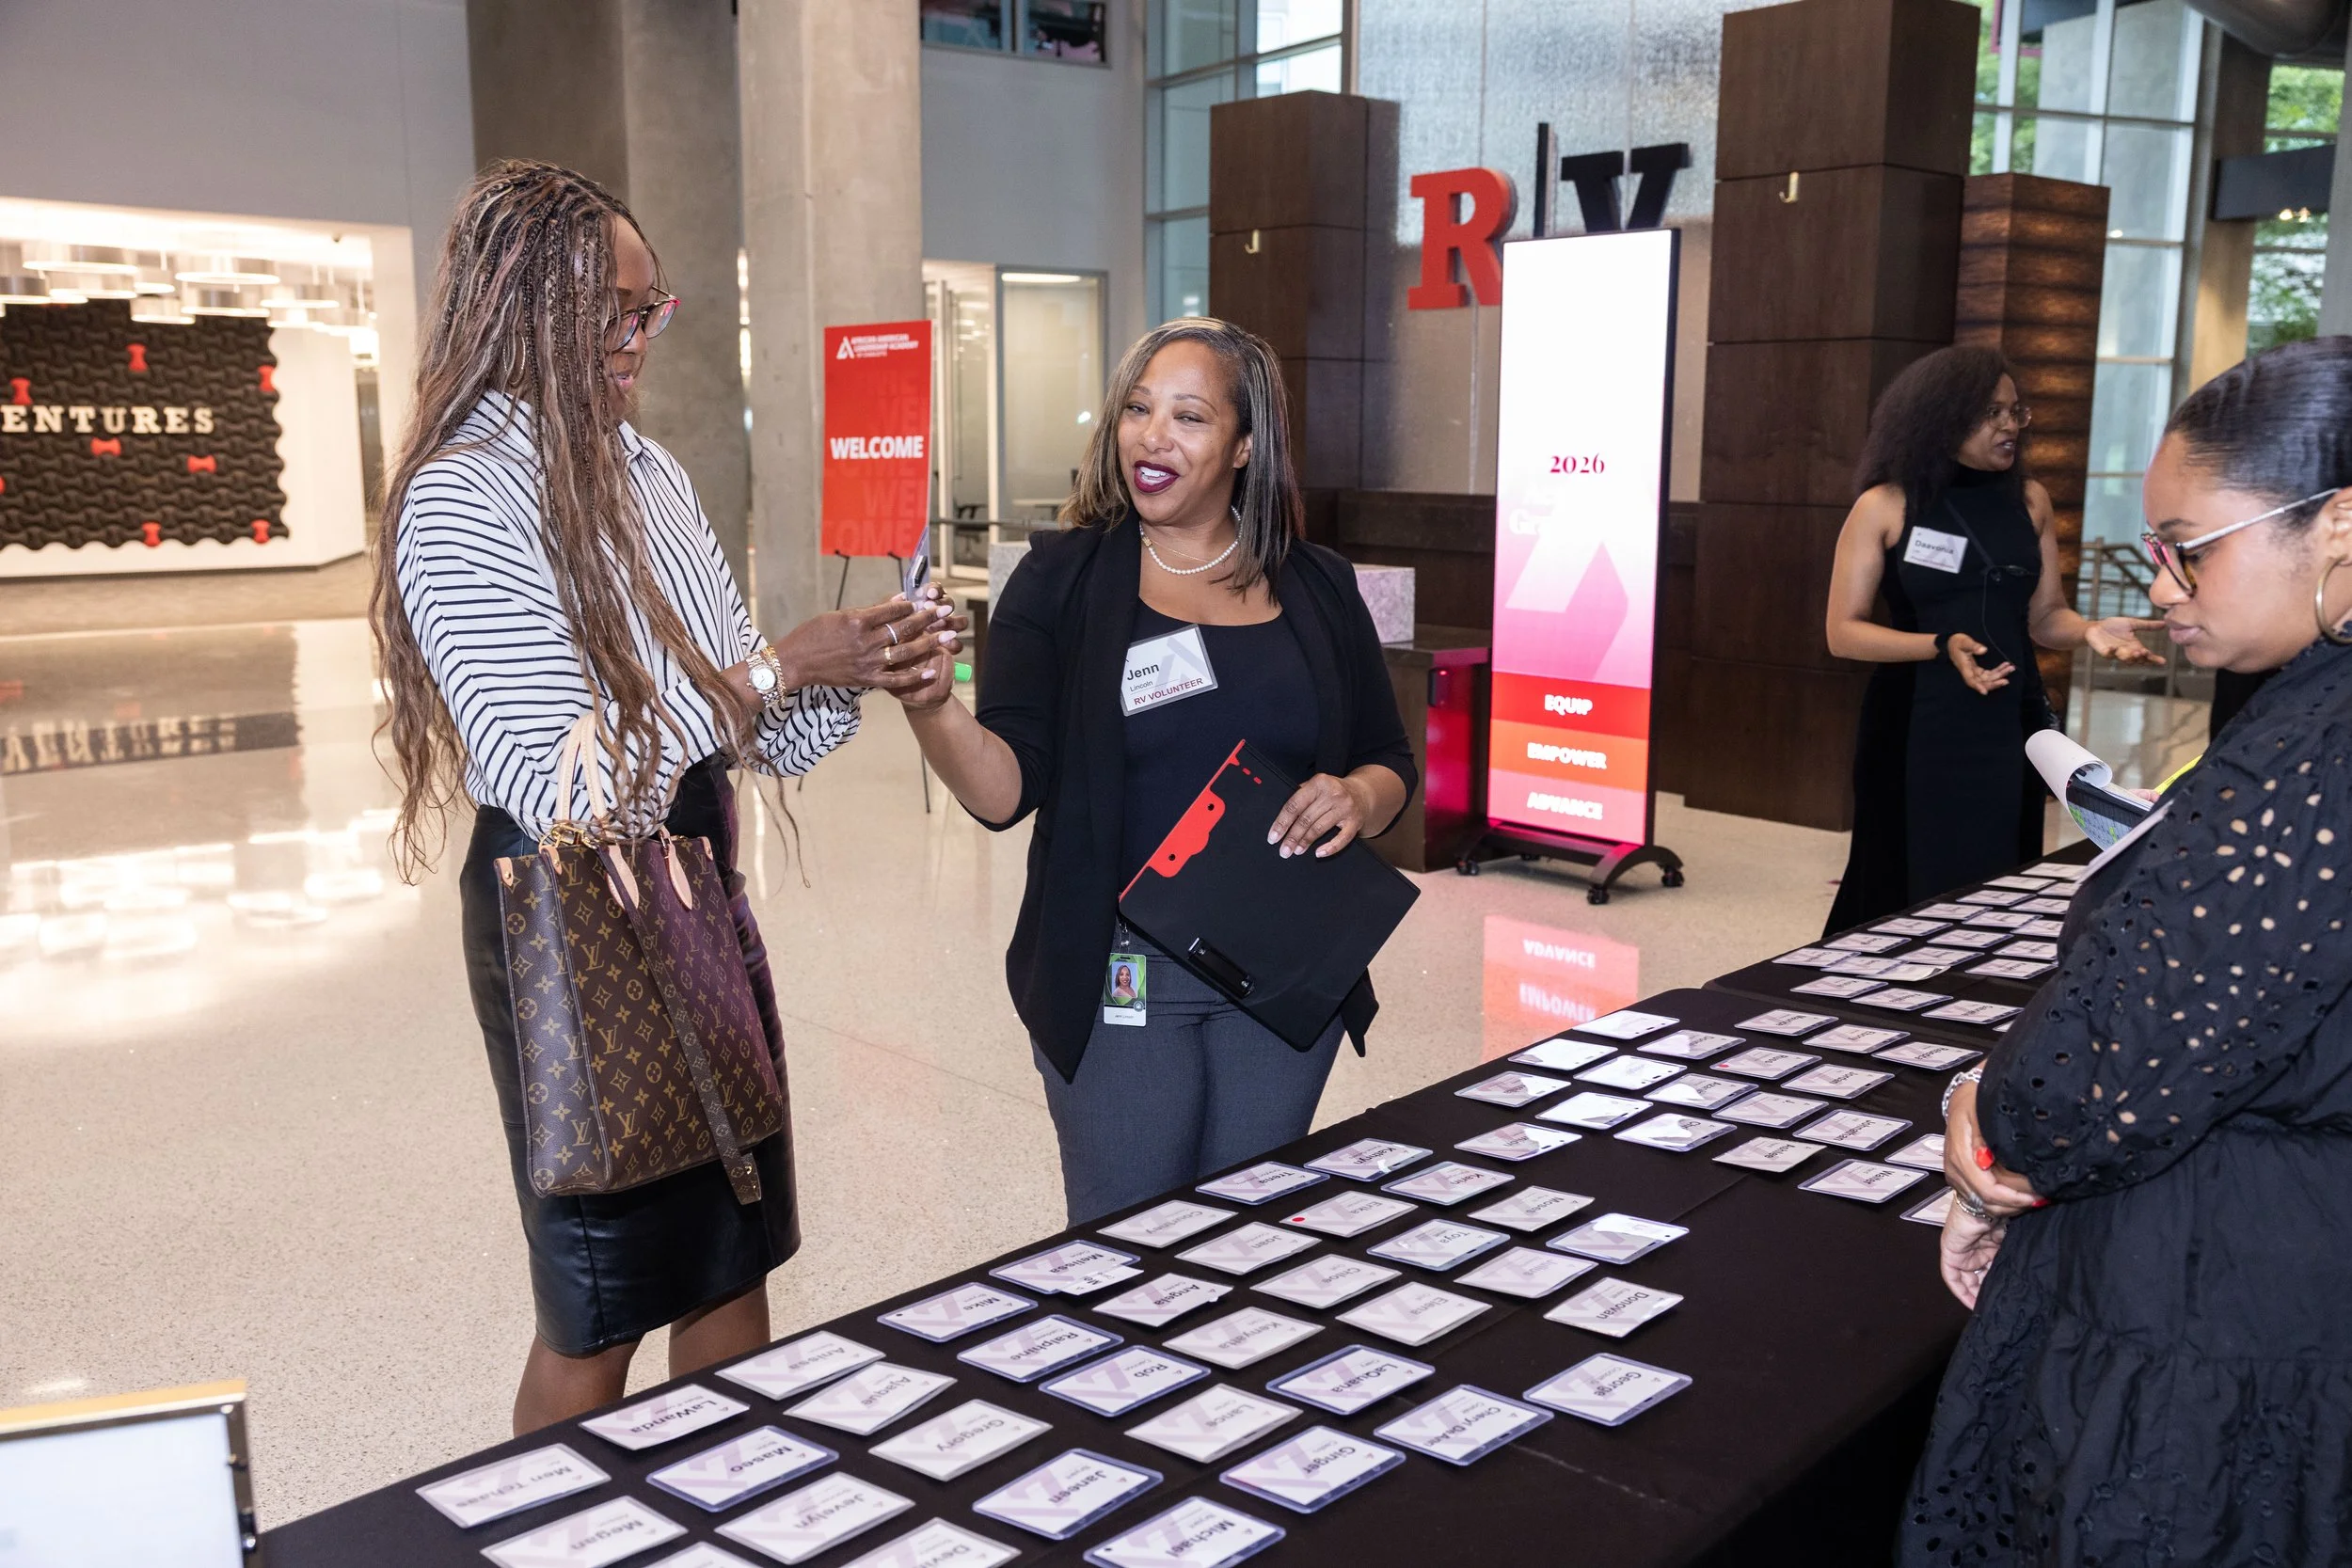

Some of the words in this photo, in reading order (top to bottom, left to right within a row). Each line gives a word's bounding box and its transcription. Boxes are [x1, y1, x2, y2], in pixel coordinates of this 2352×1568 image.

[830, 436, 923, 459] WELCOME
[1549, 453, 1606, 475] 2026
[1127, 664, 1160, 681] Jenn
[1130, 680, 1153, 692] Lincoln
[1134, 696, 1146, 705] RV
[1149, 678, 1204, 701] VOLUNTEER
[1544, 694, 1593, 717] EQUIP
[1527, 742, 1607, 769] EMPOWER
[1354, 1147, 1397, 1165] Kathryn
[1259, 1171, 1295, 1185] Trena
[1250, 1235, 1280, 1249] Joan
[1439, 1230, 1469, 1243] Toya
[1049, 1253, 1104, 1274] Melissa
[1322, 1267, 1361, 1284] Chloe
[963, 1295, 1001, 1311] Mike
[1153, 1284, 1200, 1306] Angela
[1408, 1296, 1449, 1317] Elena
[1597, 1291, 1649, 1321] Donovan
[1009, 1332, 1079, 1361] Ralphine
[1218, 1322, 1282, 1351] Kenyatta
[1134, 1362, 1169, 1379] Rob
[1331, 1362, 1398, 1394] LaQuana
[1594, 1371, 1642, 1398] George
[629, 1400, 718, 1433] LaWanda
[1205, 1403, 1255, 1428] Lance
[1463, 1406, 1501, 1429] Cheryl
[936, 1418, 1005, 1452] Gregory
[1302, 1446, 1357, 1475] Ginger
[531, 1465, 574, 1482] Men
[1049, 1471, 1107, 1504] Janeen
[570, 1520, 644, 1551] Megan
[1165, 1520, 1235, 1558] Michael
